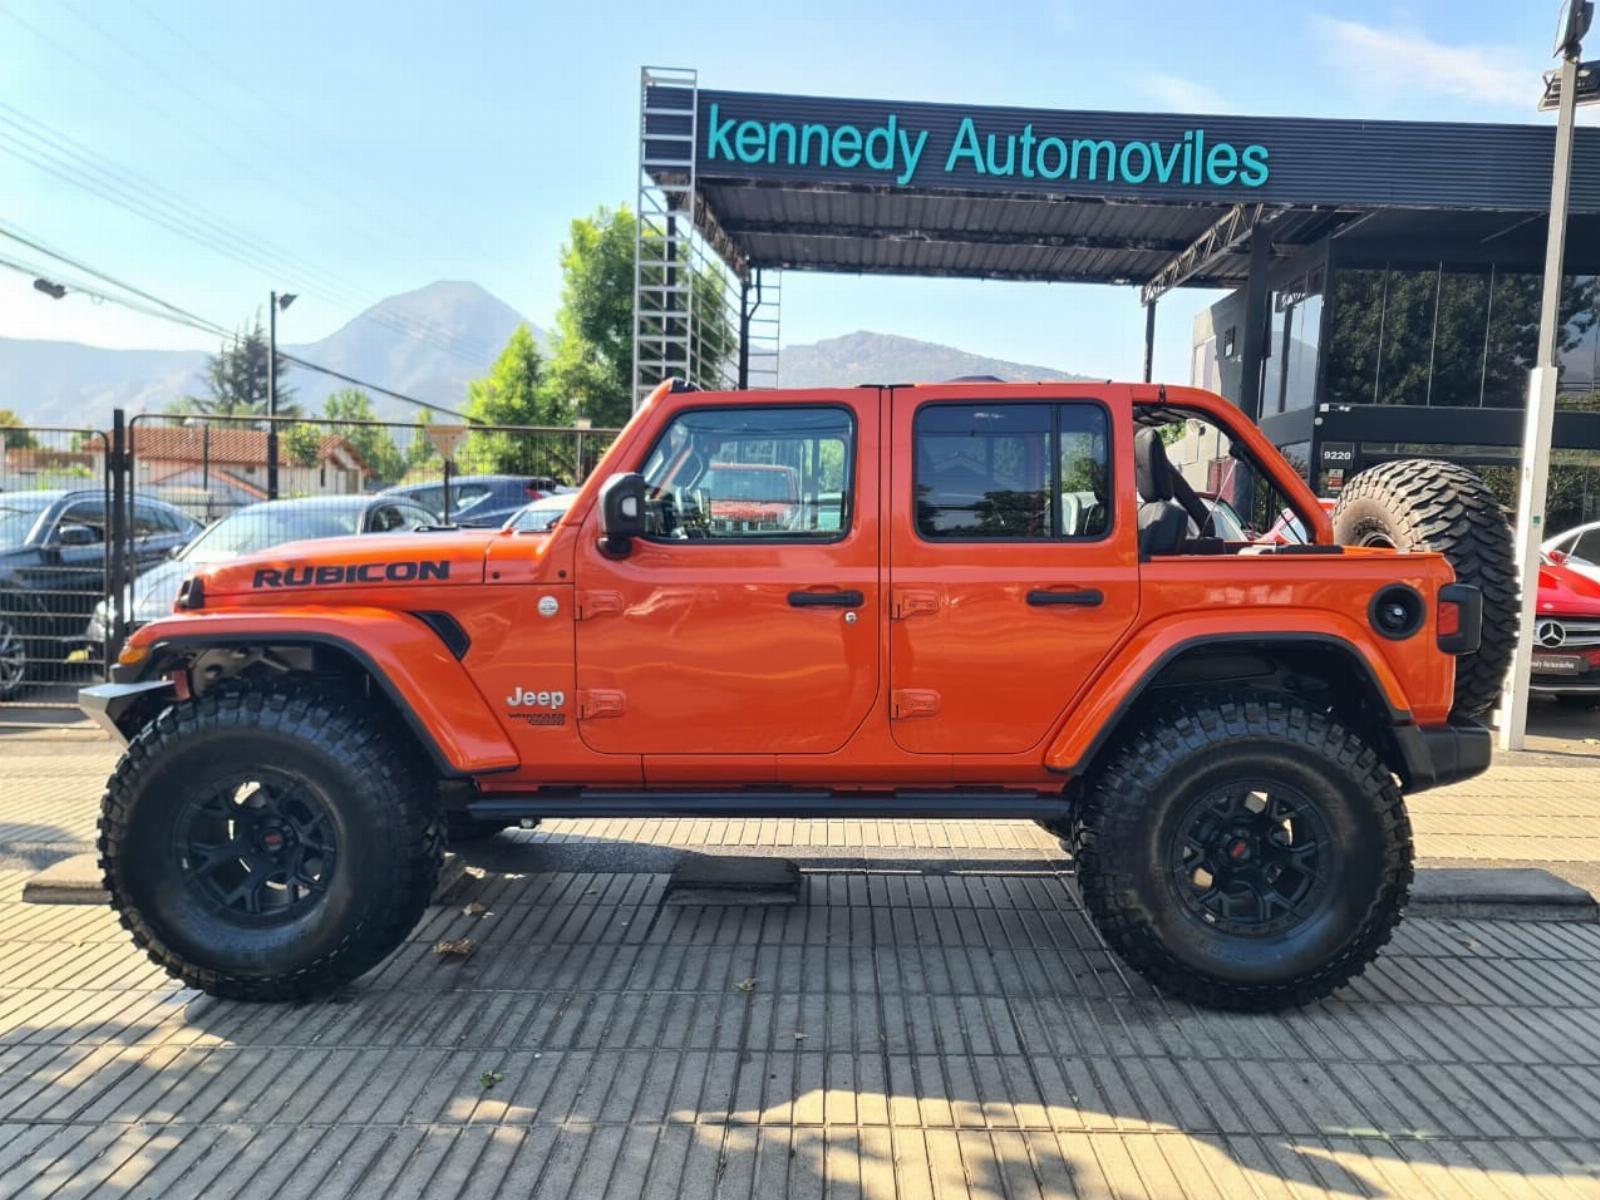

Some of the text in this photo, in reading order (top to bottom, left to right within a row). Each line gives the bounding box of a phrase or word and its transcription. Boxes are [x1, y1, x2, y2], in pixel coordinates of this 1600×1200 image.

[707, 103, 1270, 188] kennedy Automoviles
[1324, 451, 1351, 460] 9220
[252, 560, 451, 589] RUBICON
[506, 687, 565, 710] Jeep
